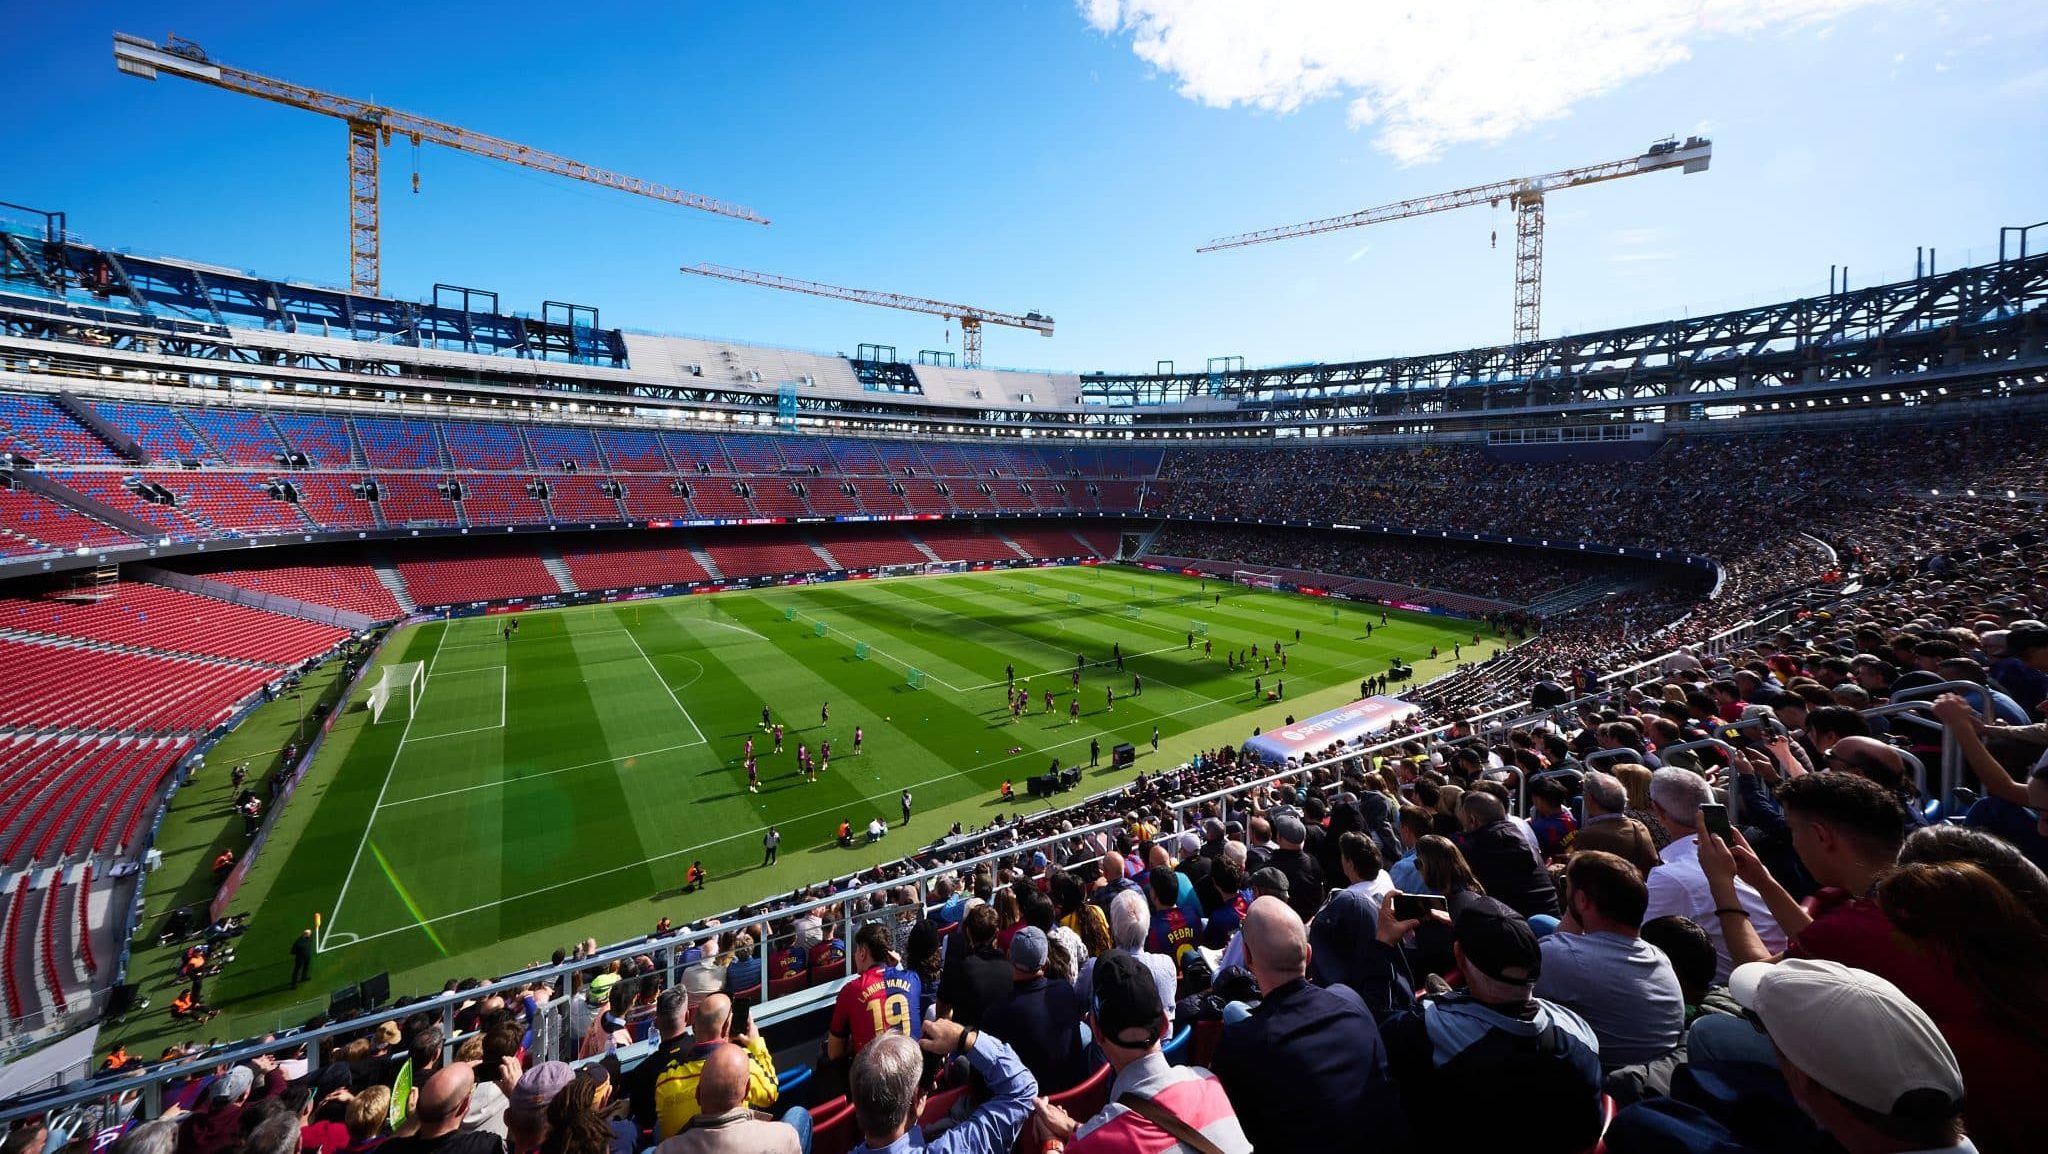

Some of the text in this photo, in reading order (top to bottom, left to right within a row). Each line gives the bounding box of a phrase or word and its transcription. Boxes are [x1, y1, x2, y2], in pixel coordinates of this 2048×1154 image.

[1167, 927, 1194, 944] PEDRI
[858, 978, 912, 1004] LAMINE YAMAL
[866, 993, 911, 1039] 19
